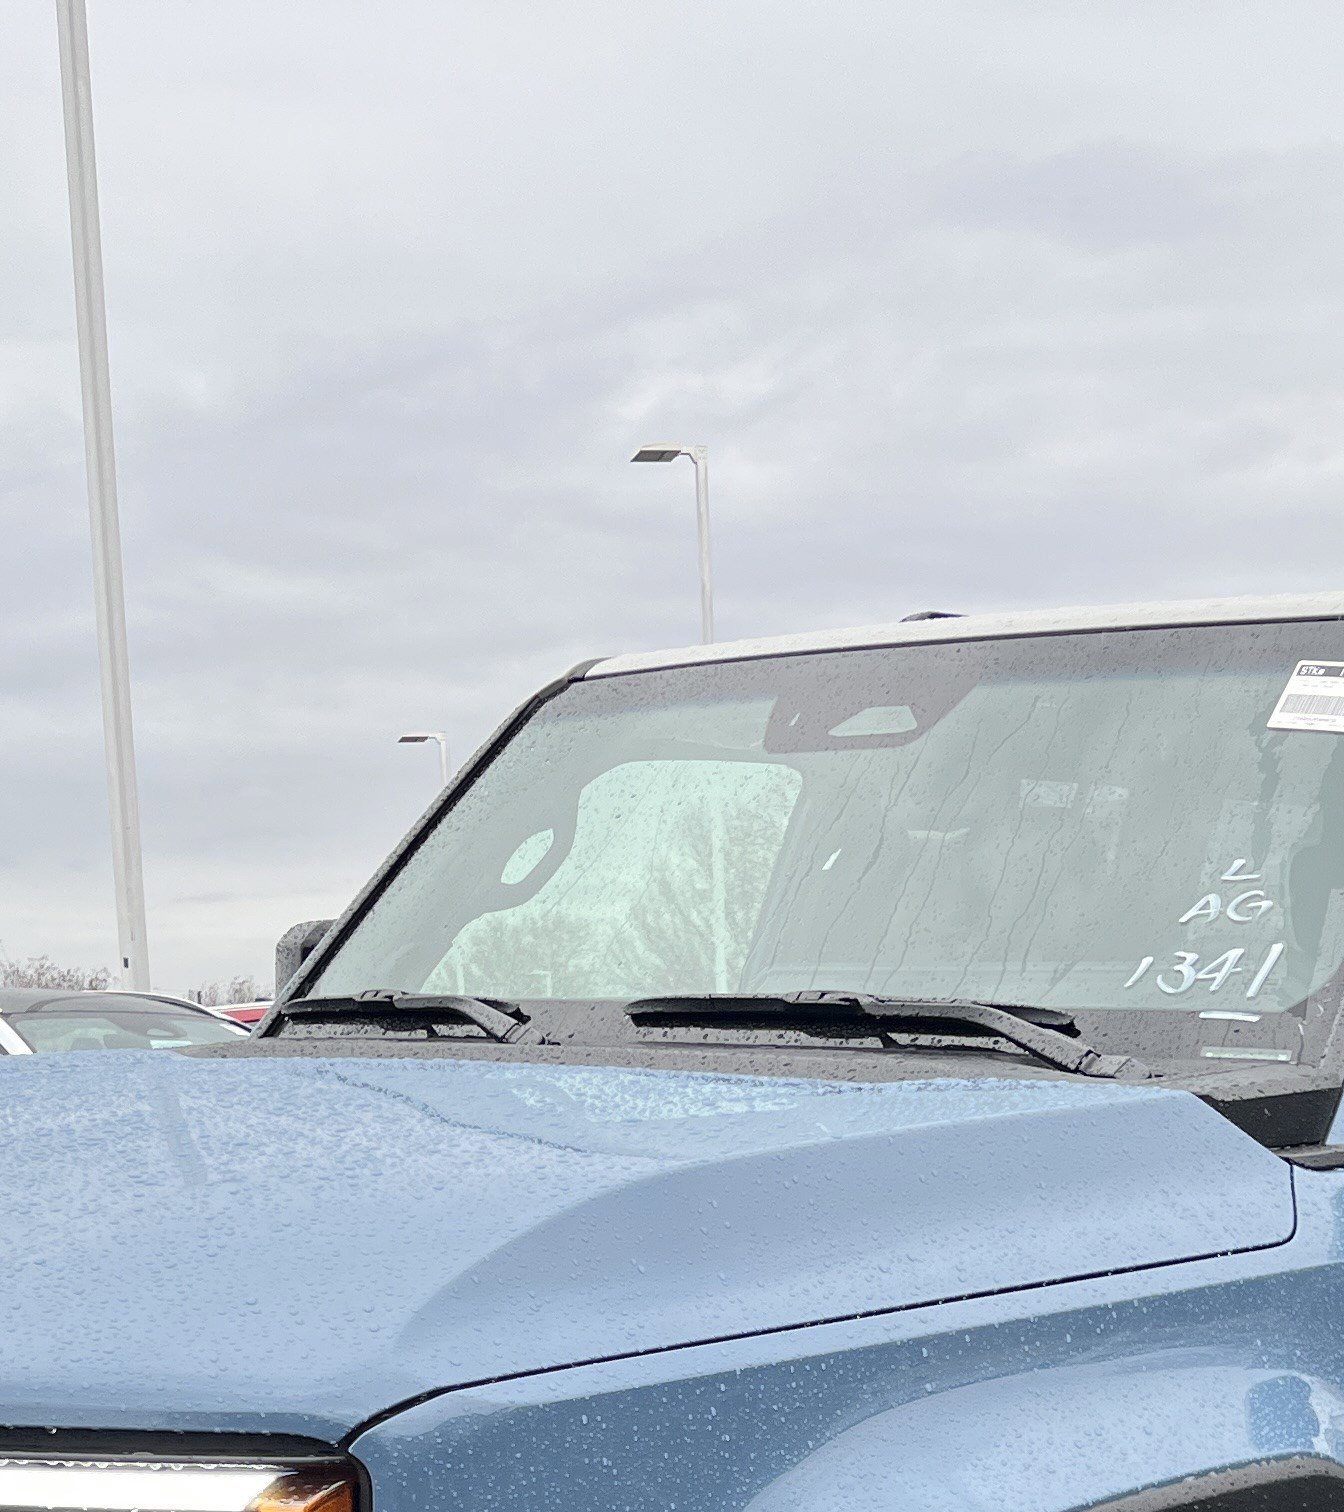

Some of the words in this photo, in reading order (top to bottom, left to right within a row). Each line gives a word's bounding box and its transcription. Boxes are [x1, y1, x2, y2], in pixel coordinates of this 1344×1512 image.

[1221, 858, 1262, 881] L
[1178, 889, 1274, 923] AG
[1123, 943, 1284, 999] 1341
